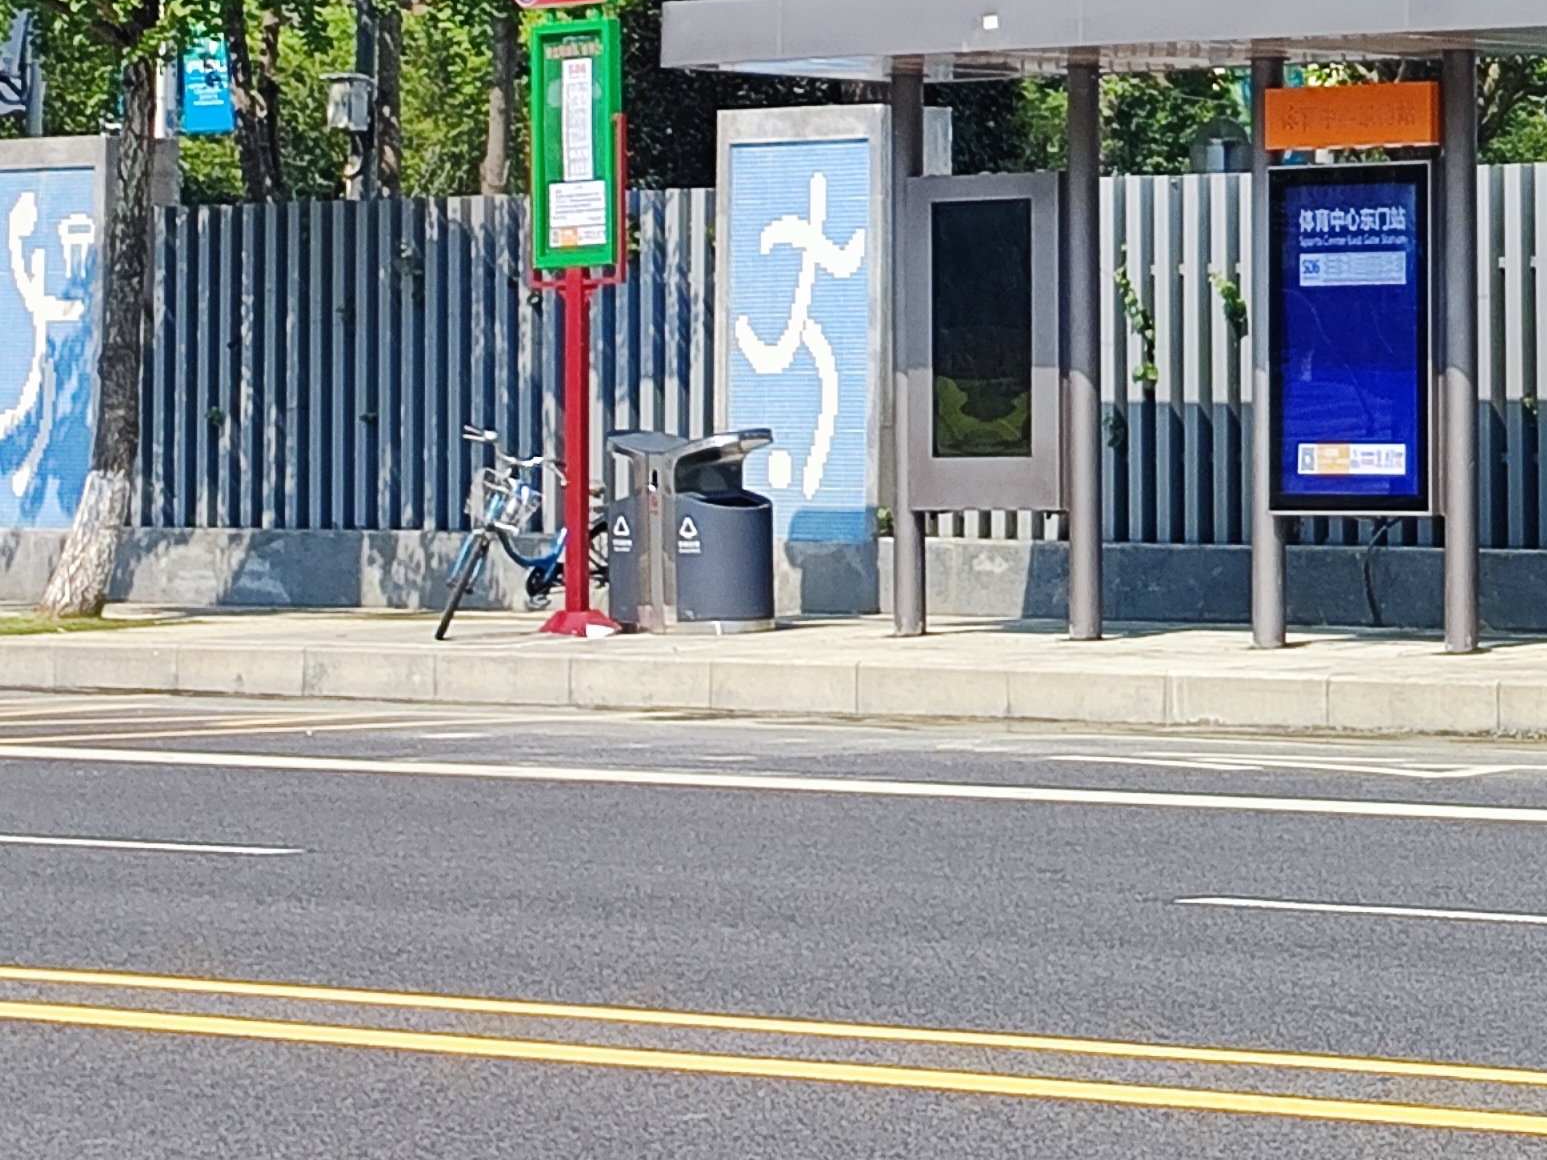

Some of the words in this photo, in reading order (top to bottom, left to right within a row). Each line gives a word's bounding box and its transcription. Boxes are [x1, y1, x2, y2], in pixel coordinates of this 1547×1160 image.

[1299, 206, 1406, 233] 体育中心东门站
